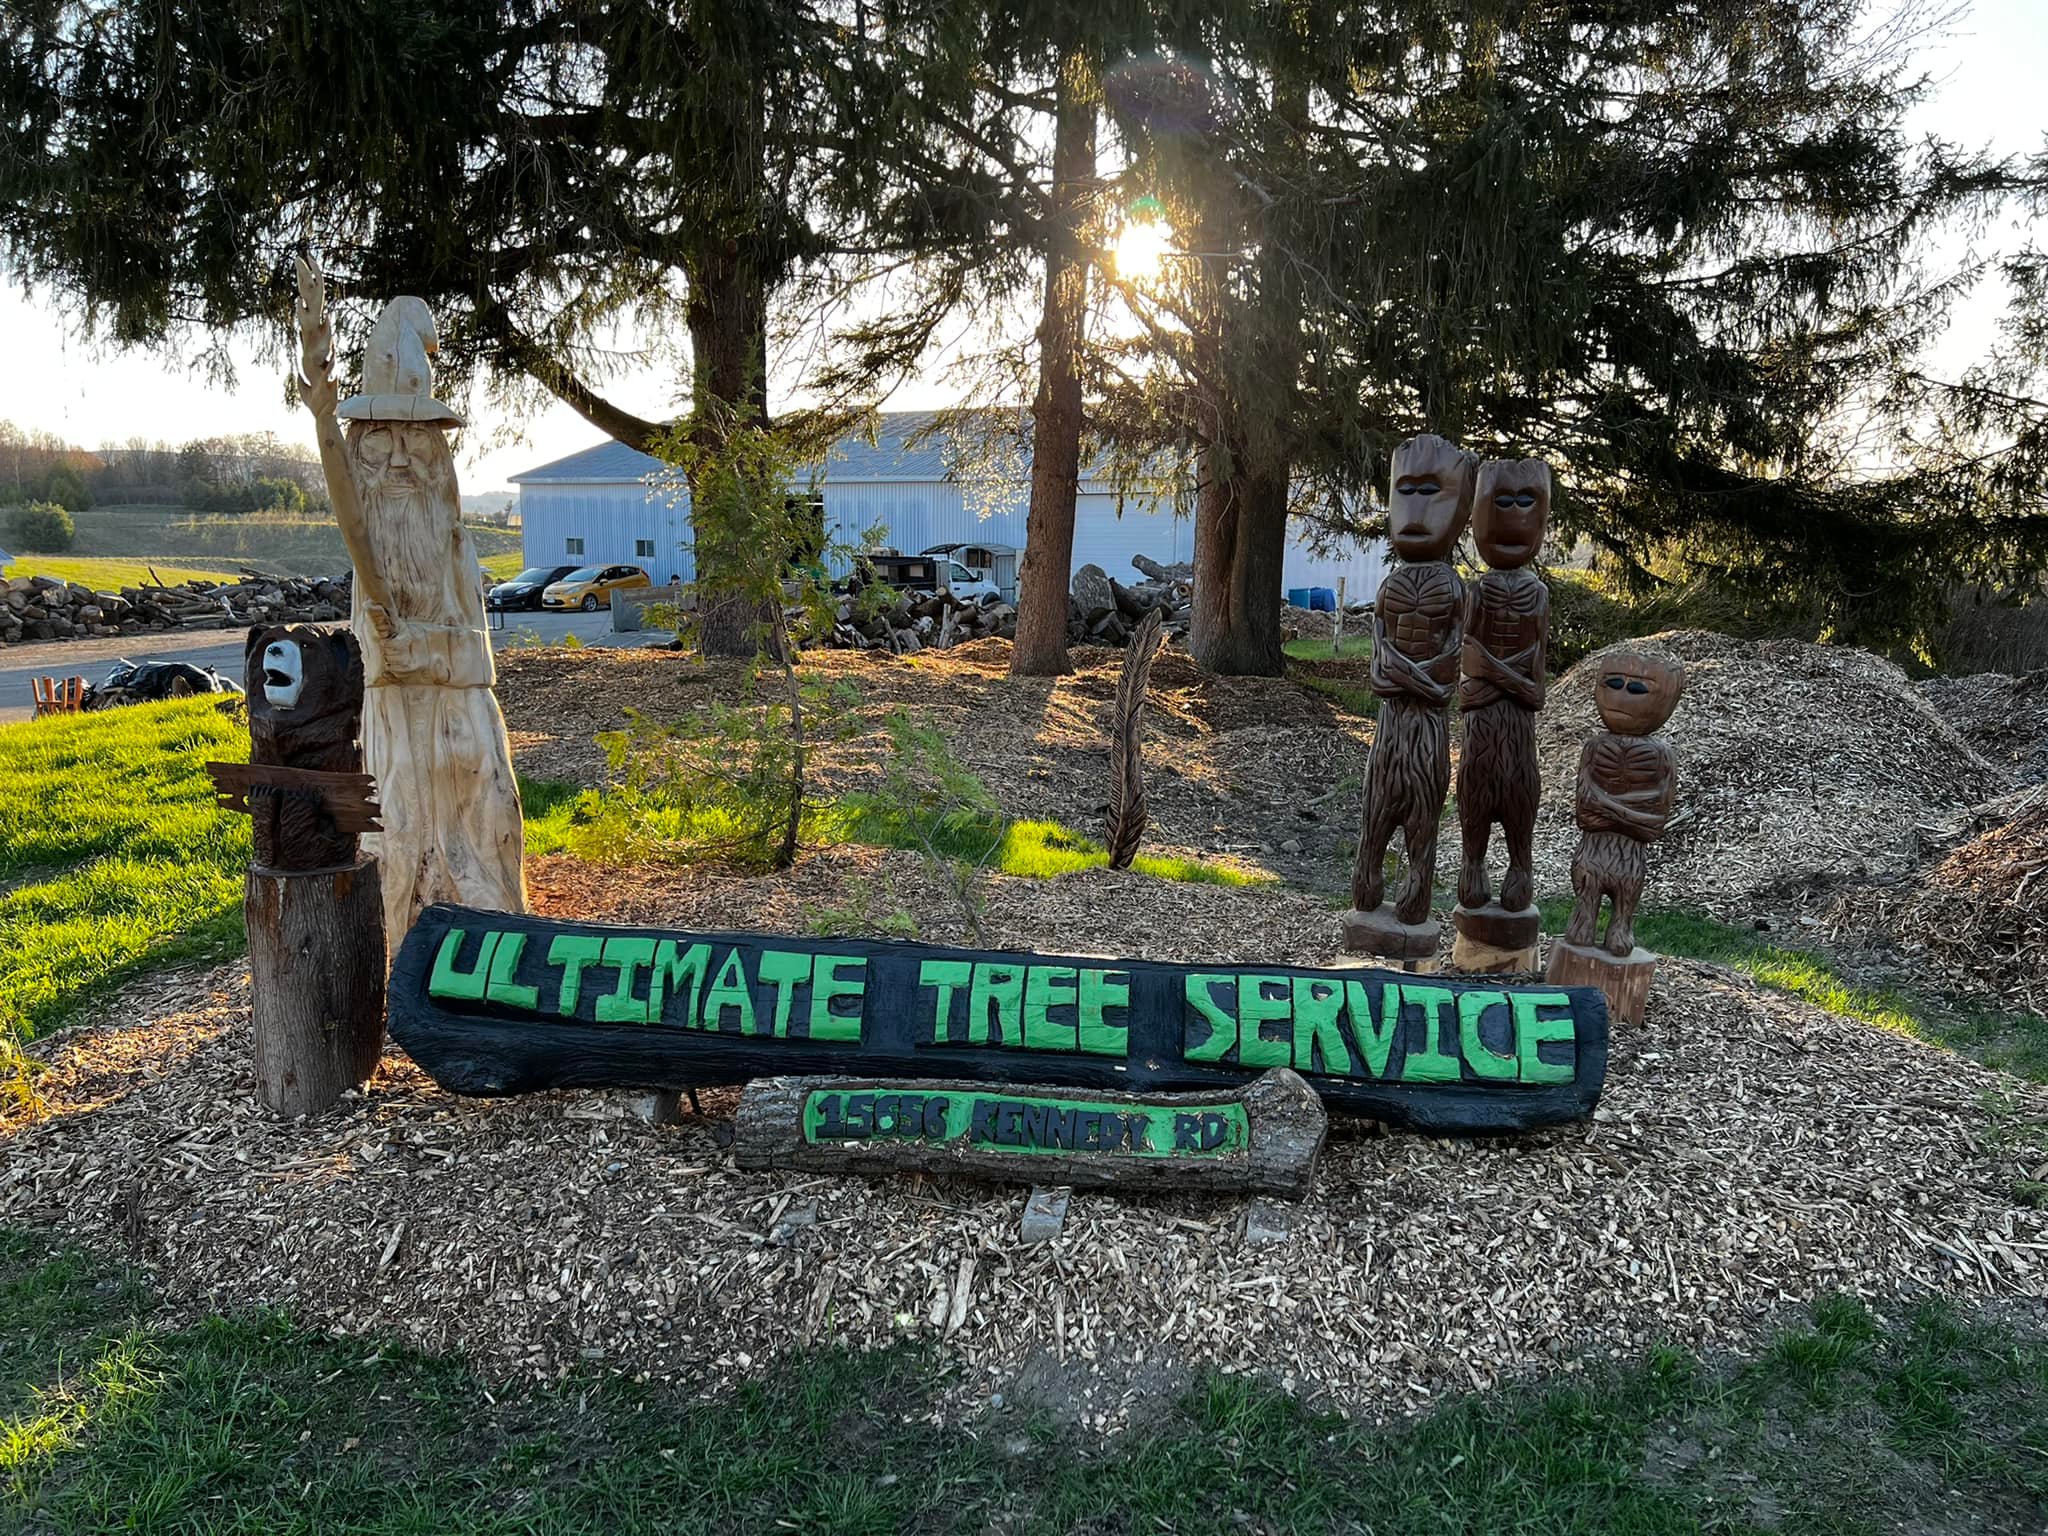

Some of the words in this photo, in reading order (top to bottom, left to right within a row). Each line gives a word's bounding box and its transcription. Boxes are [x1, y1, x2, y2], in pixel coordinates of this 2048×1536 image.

[430, 929, 867, 1041] ULTIMATE
[919, 960, 1130, 1055] TREE
[1184, 973, 1576, 1084] SERVICE
[815, 1094, 950, 1139] 15656
[970, 1099, 1150, 1150] KENNEDY
[1174, 1111, 1229, 1151] RD
